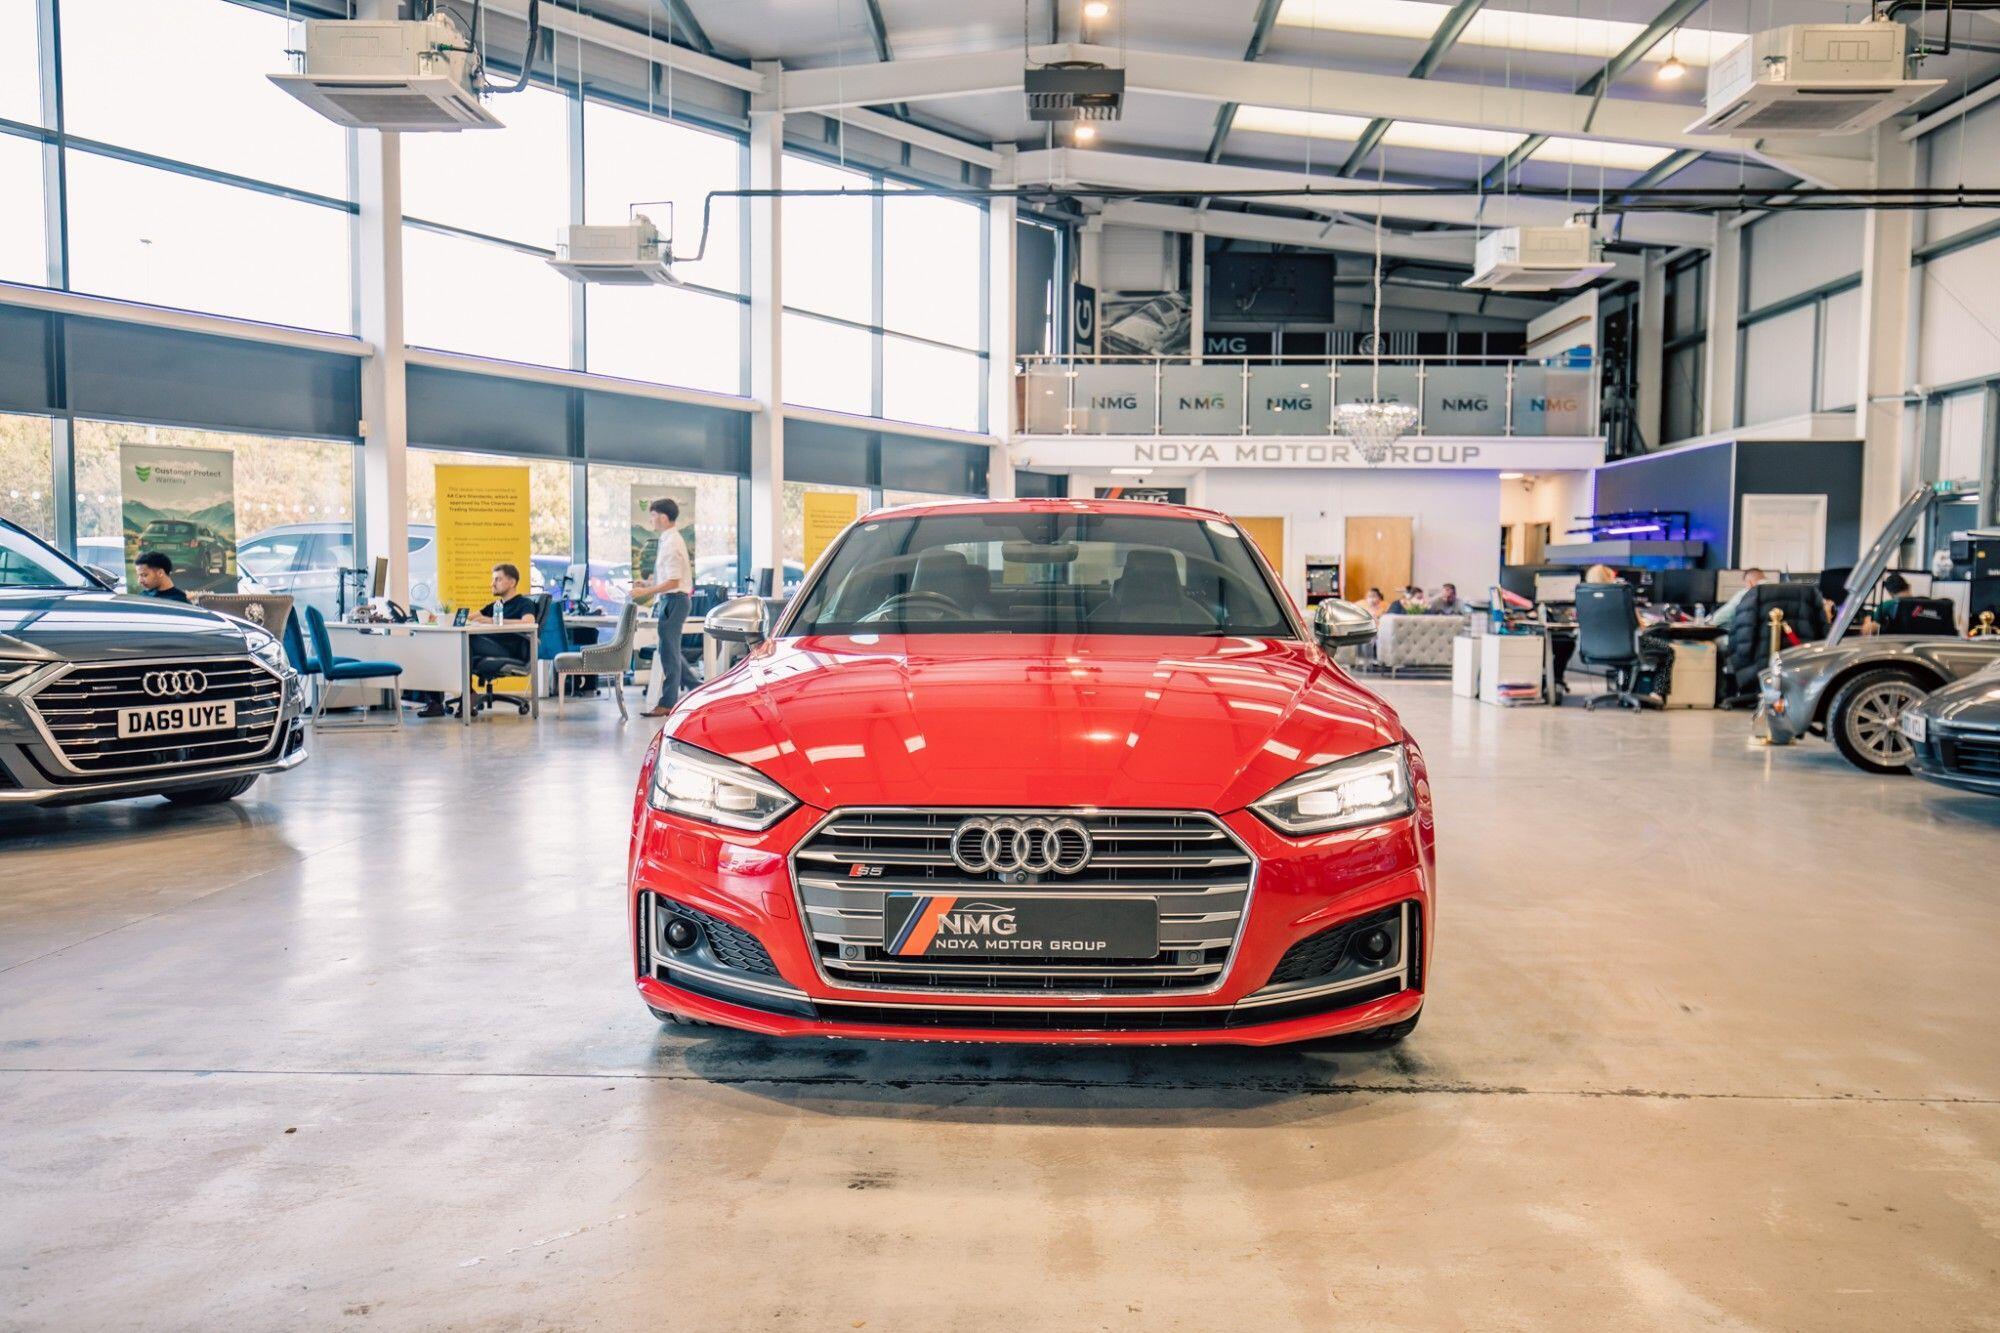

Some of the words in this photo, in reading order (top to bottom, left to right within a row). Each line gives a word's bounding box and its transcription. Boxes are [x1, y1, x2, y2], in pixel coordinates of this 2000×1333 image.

[1203, 337, 1247, 354] MG
[1091, 397, 1137, 410] NMG
[1180, 397, 1225, 410] NMG
[1266, 397, 1312, 411] NMG
[1442, 398, 1488, 411] NMG
[1531, 398, 1577, 411] NMG
[1134, 444, 1219, 462] NOYA
[1236, 445, 1349, 463] MOTOR
[154, 467, 192, 476] Customer
[193, 470, 221, 478] Protect
[128, 708, 184, 733] DA69
[189, 705, 227, 727] UYE
[856, 866, 883, 876] S5
[937, 913, 1017, 935] NMG
[936, 939, 979, 949] NOYA
[986, 940, 1043, 950] MOTOR
[1050, 941, 1107, 951] GROUP
